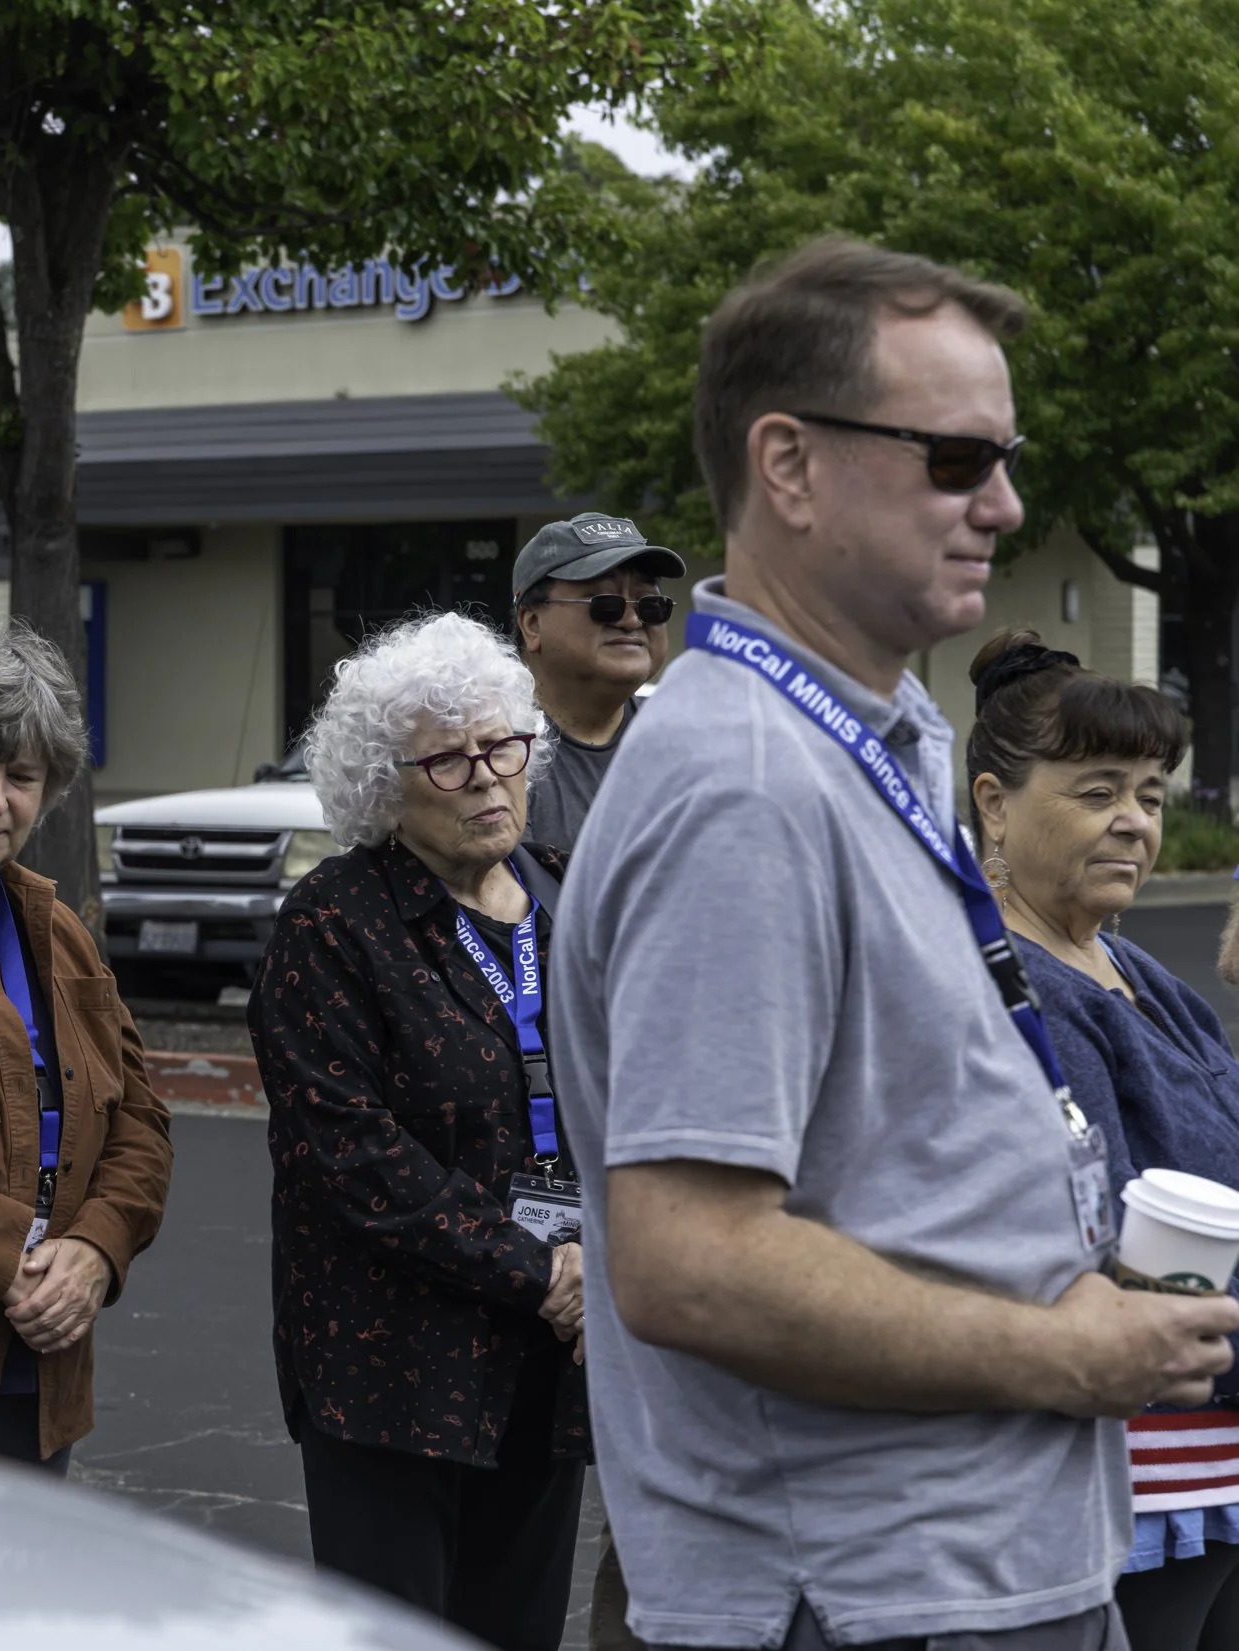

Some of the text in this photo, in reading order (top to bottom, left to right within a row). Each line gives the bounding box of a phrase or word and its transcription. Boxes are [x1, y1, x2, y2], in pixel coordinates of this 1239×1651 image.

[192, 250, 464, 321] Exchange
[581, 522, 633, 535] ITALIA
[706, 620, 793, 681] NorCal
[786, 672, 862, 744] MINIS
[859, 738, 910, 810] Since
[481, 962, 515, 1003] 2003
[517, 937, 538, 995] NorCal
[517, 1216, 545, 1225] CATHERINE
[518, 1206, 551, 1220] JONES
